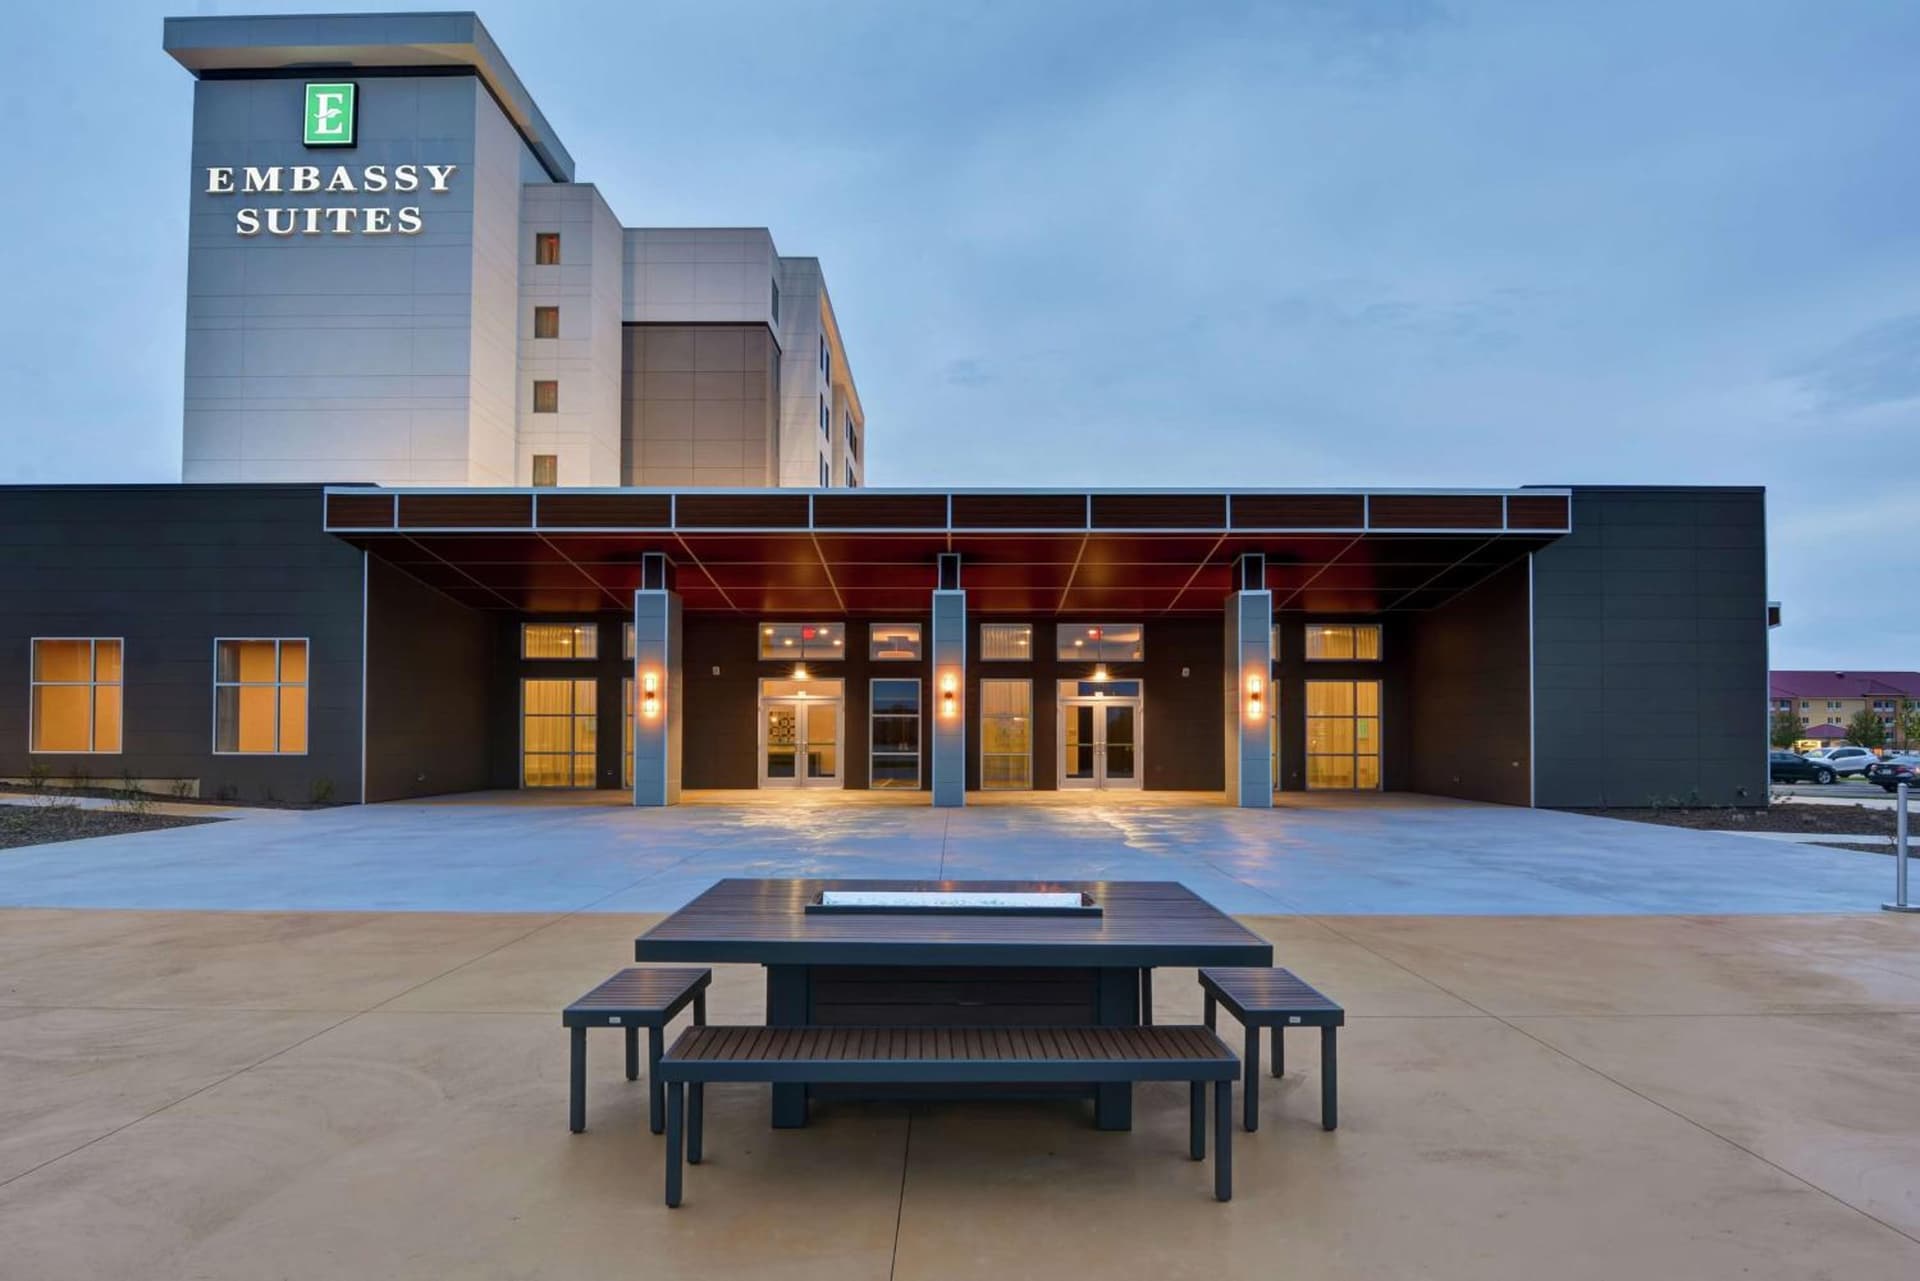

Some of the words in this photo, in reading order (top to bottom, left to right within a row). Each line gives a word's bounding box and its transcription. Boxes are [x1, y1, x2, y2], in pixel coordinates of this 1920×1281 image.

[314, 92, 343, 134] E
[205, 165, 457, 193] EMBASSY
[236, 206, 423, 234] SUITES
